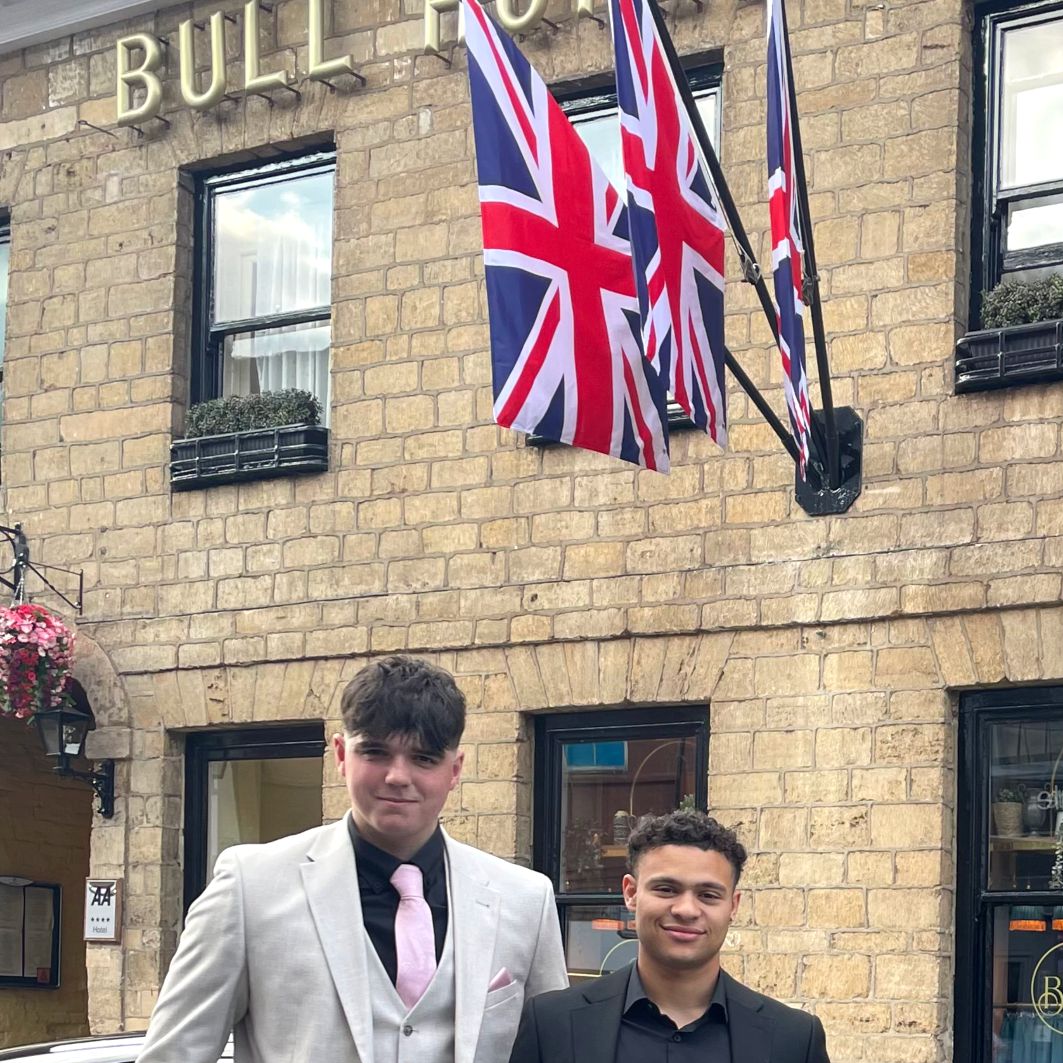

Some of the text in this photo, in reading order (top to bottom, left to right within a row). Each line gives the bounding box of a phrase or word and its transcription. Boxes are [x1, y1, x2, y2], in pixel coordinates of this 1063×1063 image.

[117, 0, 356, 128] BULL
[91, 886, 111, 906] AA
[92, 926, 108, 934] Hotel
